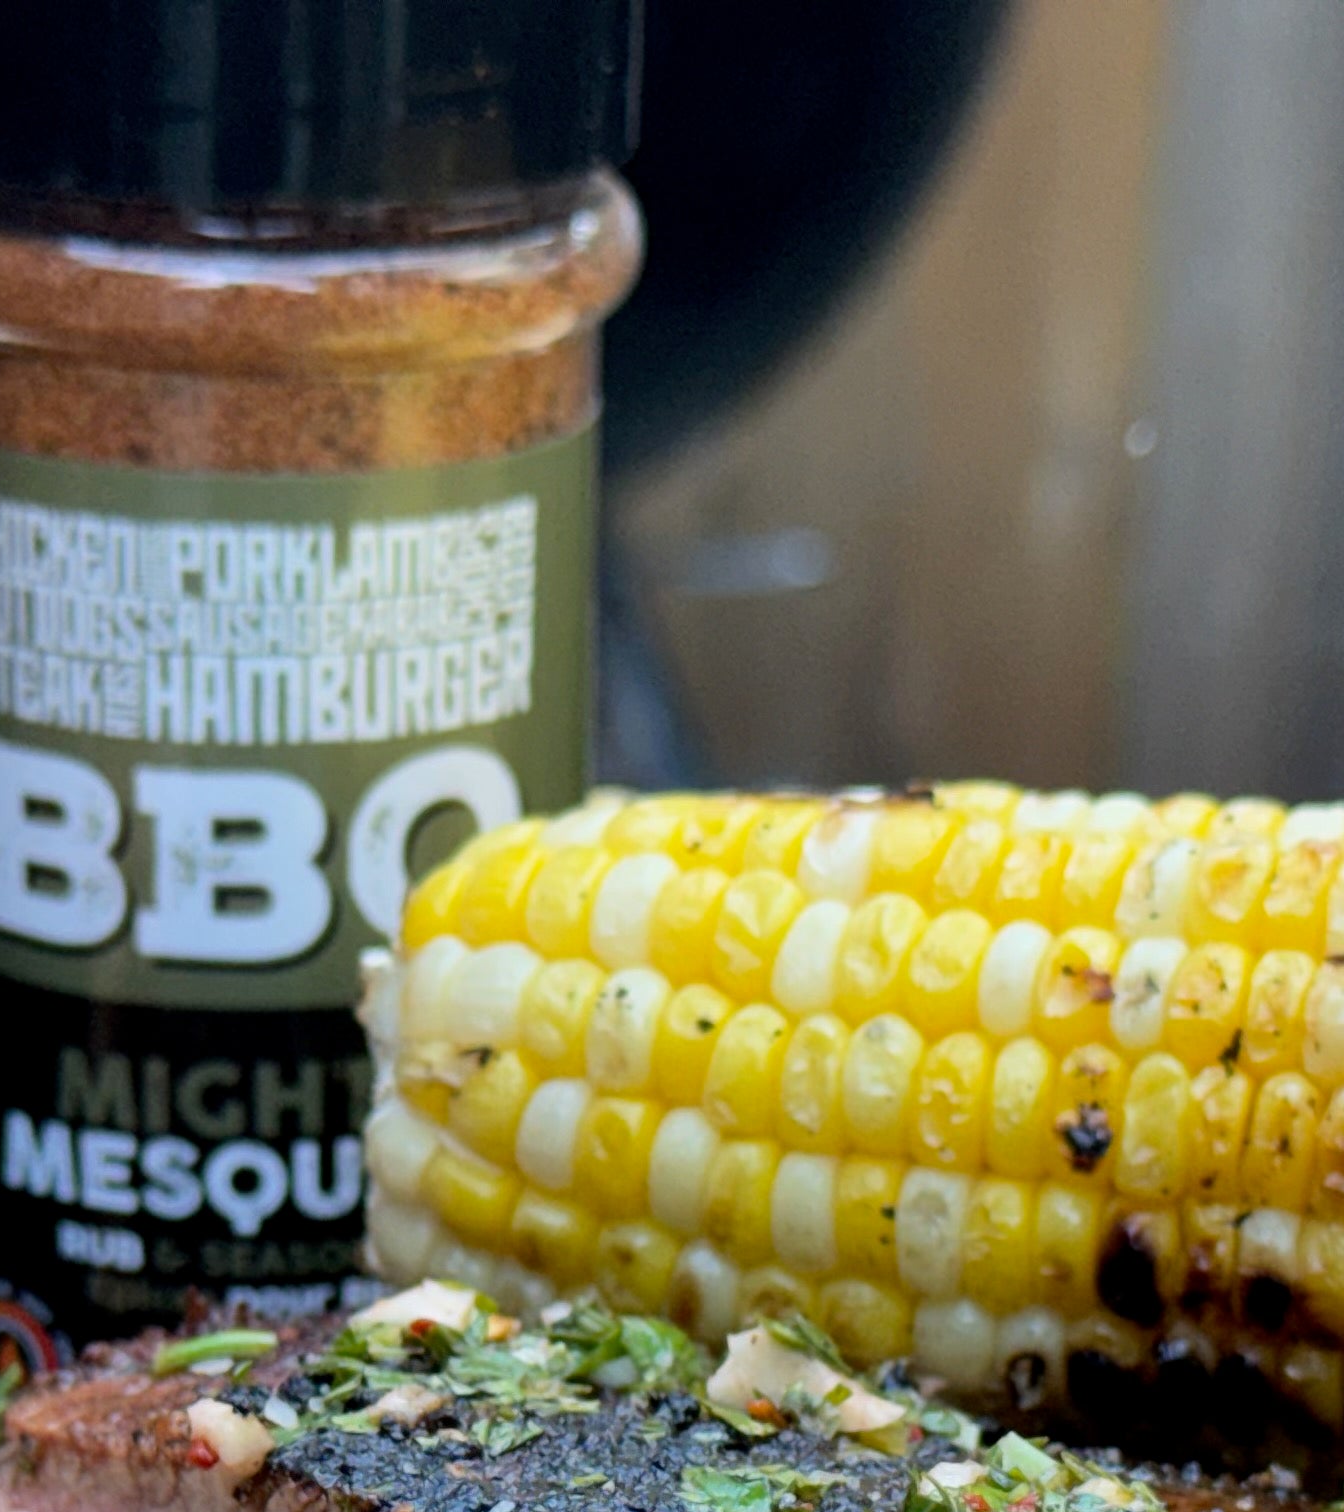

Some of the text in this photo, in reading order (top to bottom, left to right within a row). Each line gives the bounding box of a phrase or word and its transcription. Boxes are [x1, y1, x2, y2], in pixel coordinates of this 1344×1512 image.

[171, 521, 319, 603] PORK
[320, 513, 457, 602] LAMB
[144, 628, 534, 747] HAMBURGER
[58, 1045, 375, 1138] MIGHT
[1, 1108, 365, 1238] MESQU
[56, 1217, 145, 1273] RUB
